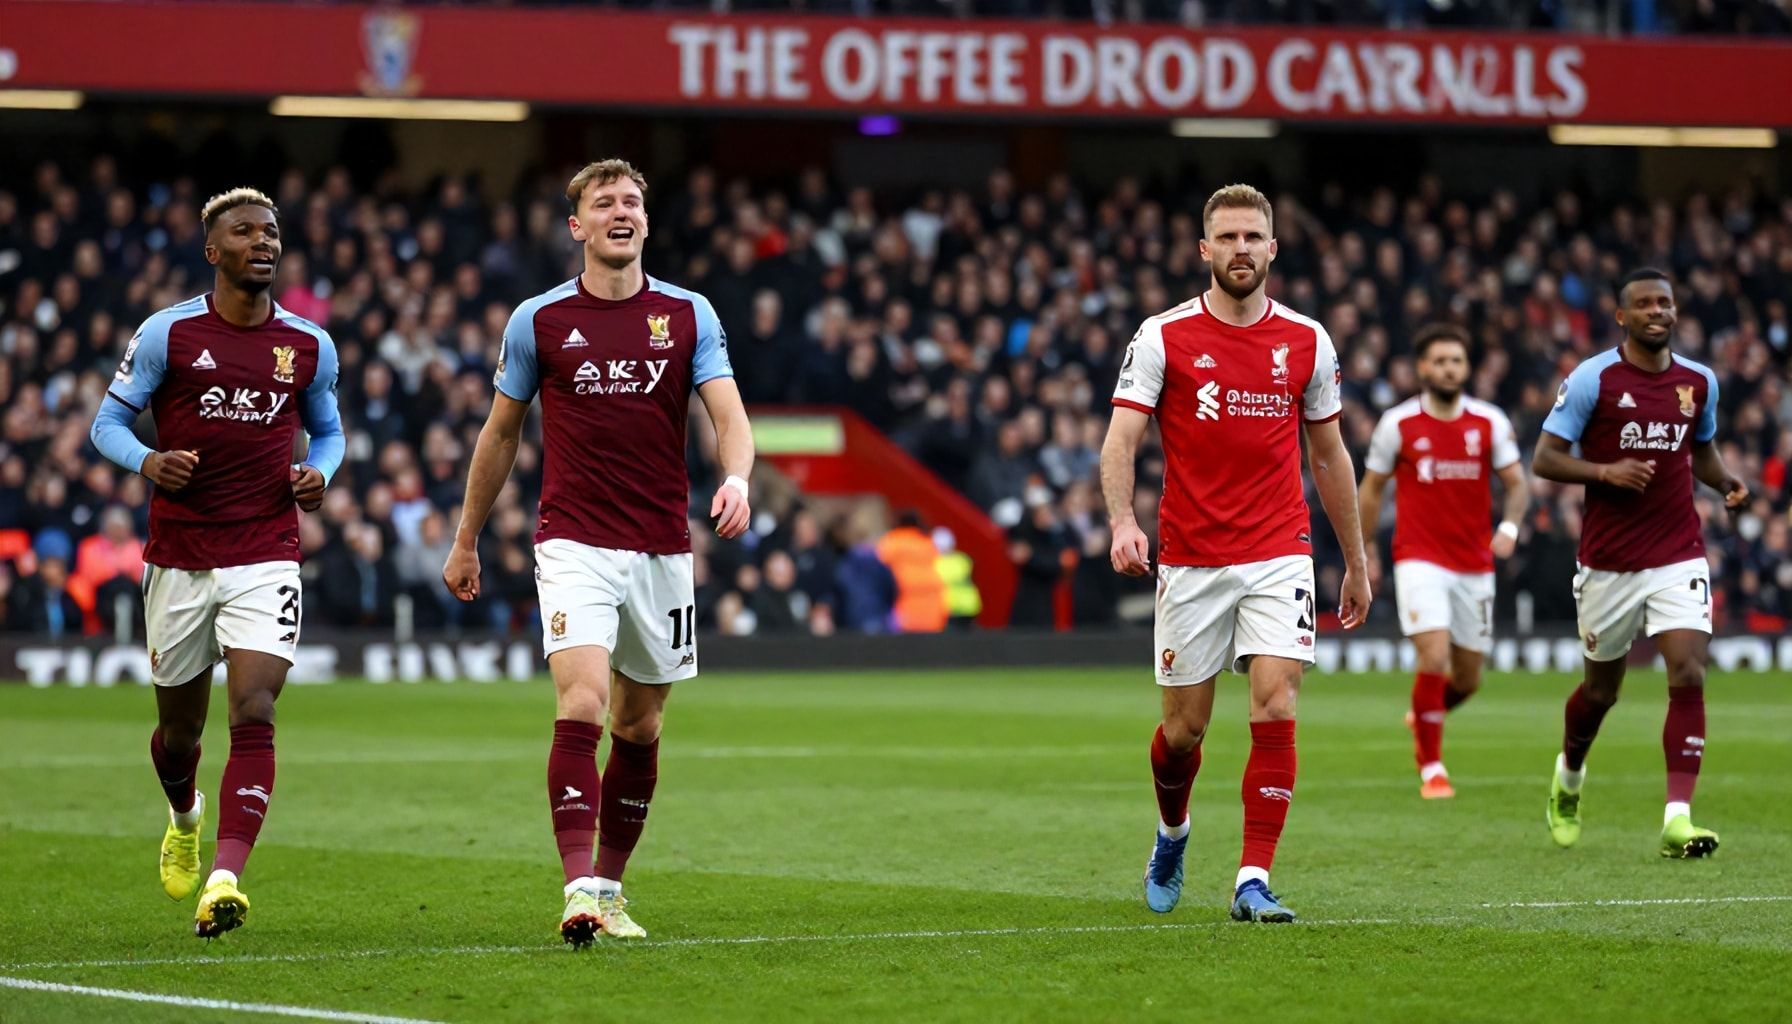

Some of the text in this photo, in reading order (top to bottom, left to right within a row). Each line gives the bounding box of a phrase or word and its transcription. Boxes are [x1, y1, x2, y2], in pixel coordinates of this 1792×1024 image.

[669, 25, 808, 98] THE
[822, 27, 1026, 102] OFFEE
[1042, 36, 1256, 109] DROD
[667, 604, 694, 650] 11
